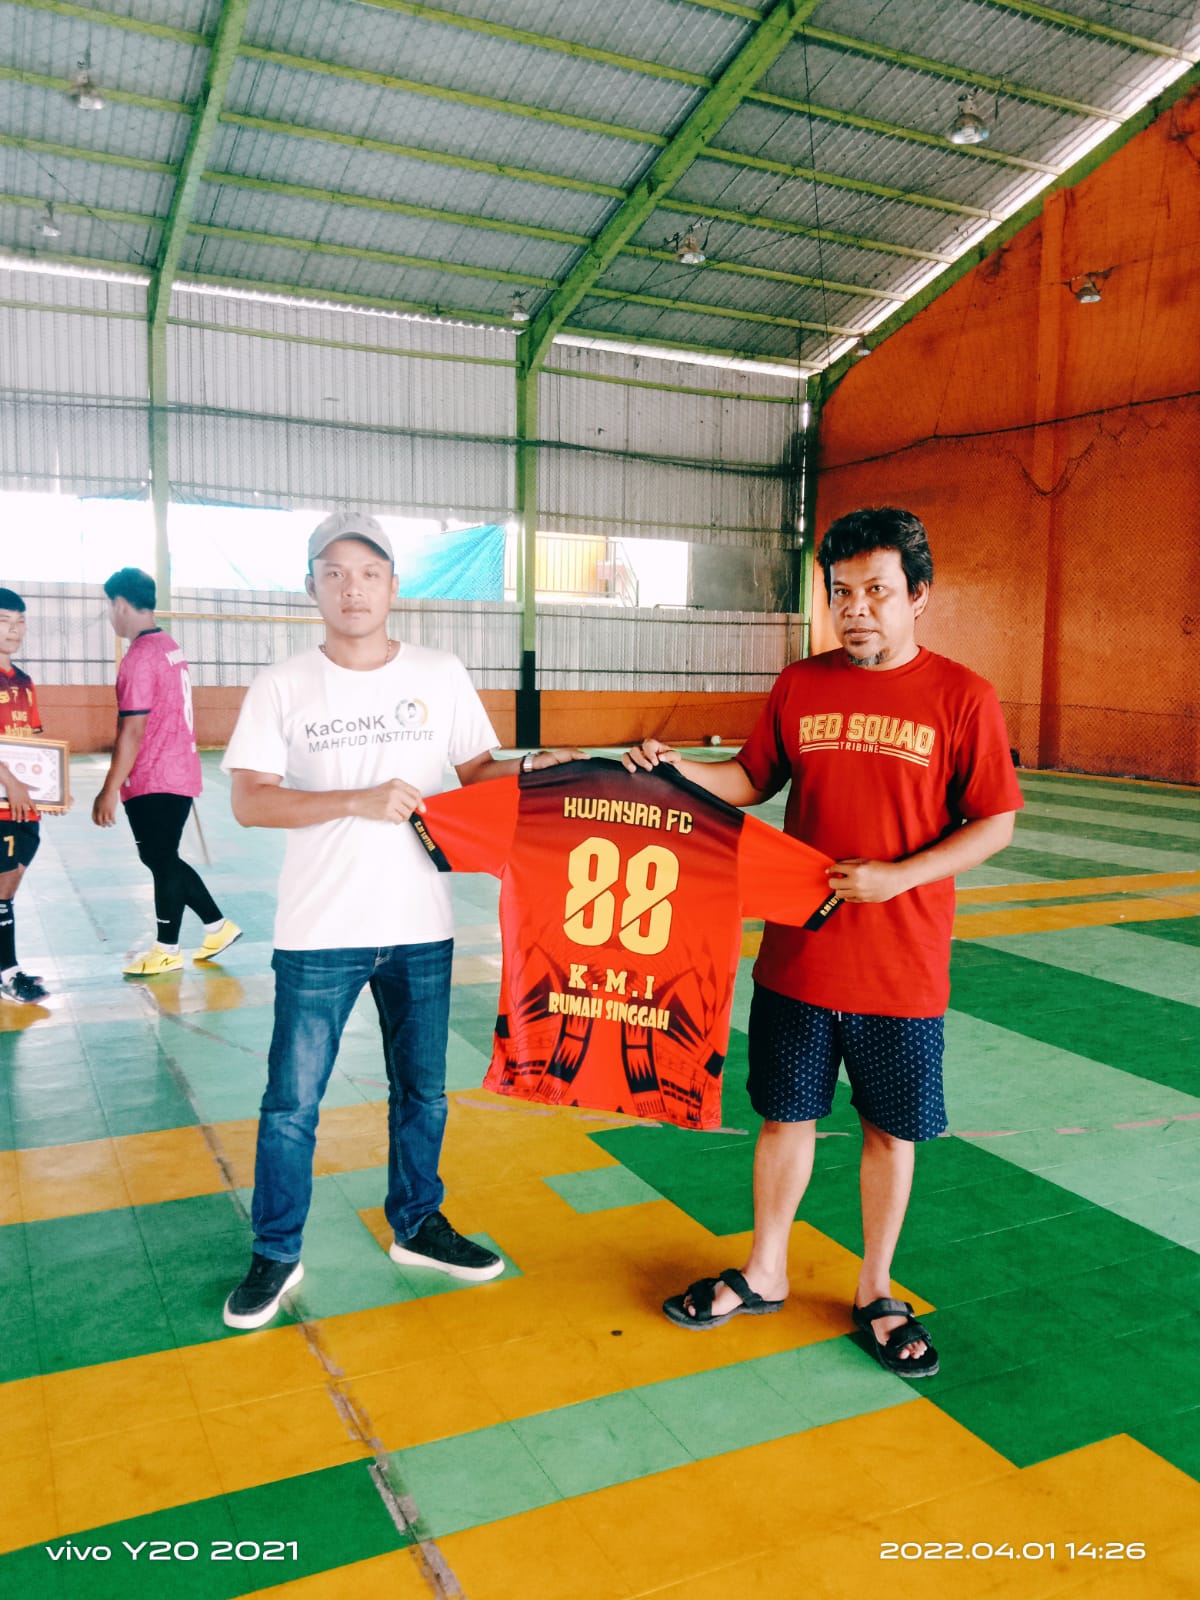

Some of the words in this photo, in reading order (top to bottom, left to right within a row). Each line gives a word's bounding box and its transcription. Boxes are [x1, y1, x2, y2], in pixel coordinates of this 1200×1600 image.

[305, 715, 386, 739] KaCoNK
[308, 734, 368, 753] MAHFUD
[371, 730, 434, 744] INSTITUTE
[799, 712, 843, 743] RED
[846, 712, 936, 756] SQUAD
[840, 741, 880, 753] TRIBUNE
[563, 796, 662, 829] KWANYAR
[665, 808, 693, 834] FC
[3, 835, 14, 857] 7
[562, 836, 680, 955] 88
[548, 992, 603, 1019] RUMAH
[605, 999, 670, 1031] SINGGAH
